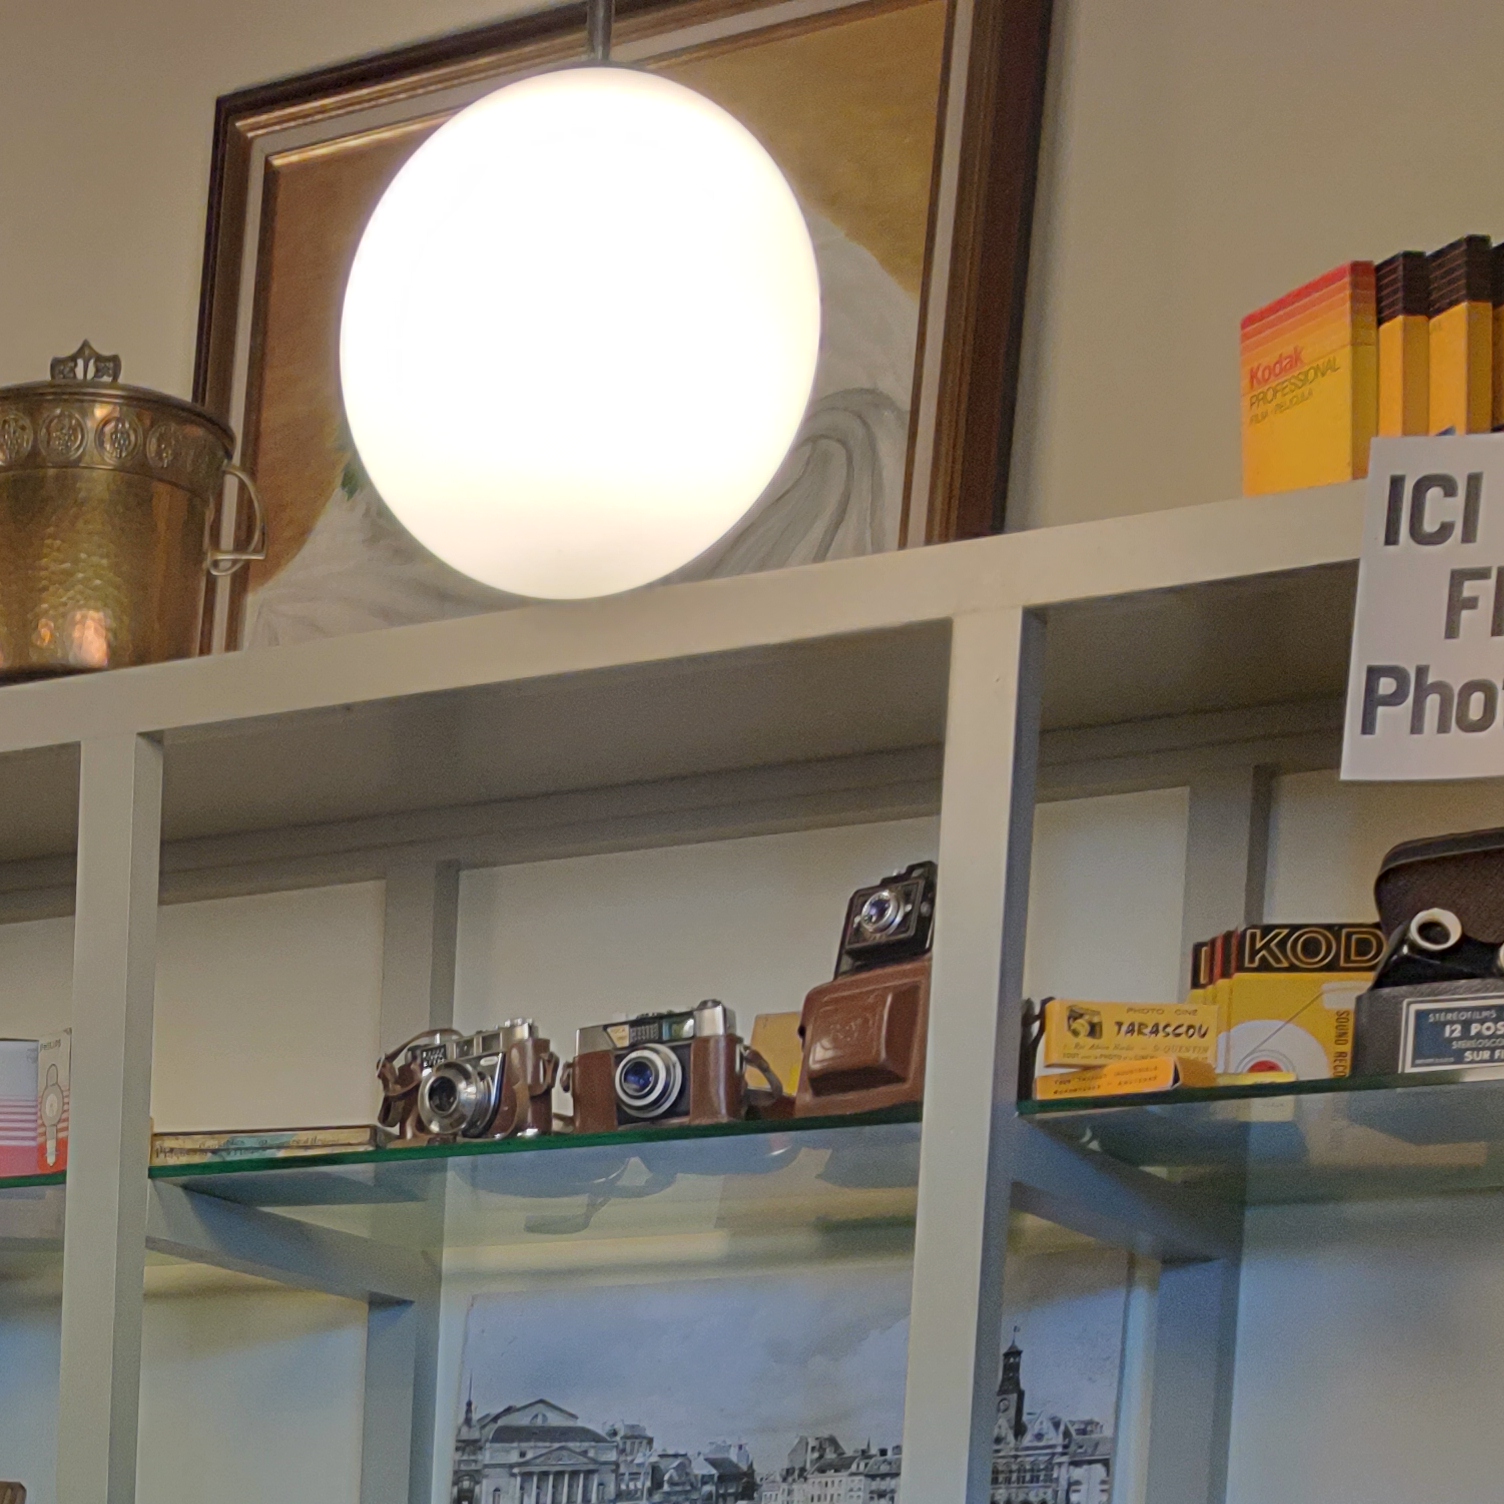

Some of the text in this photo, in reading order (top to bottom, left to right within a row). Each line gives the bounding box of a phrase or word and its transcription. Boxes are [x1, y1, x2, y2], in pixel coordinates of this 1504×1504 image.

[1249, 344, 1305, 391] Kodak
[1248, 355, 1341, 411] PROFESSIONAL
[1383, 471, 1484, 546] ICI
[1126, 1007, 1166, 1016] PHOTO
[1113, 1020, 1210, 1040] TARASCOU
[1335, 1009, 1350, 1046] SOUND
[1444, 1023, 1462, 1038] 12
[1463, 1049, 1491, 1063] SUR
